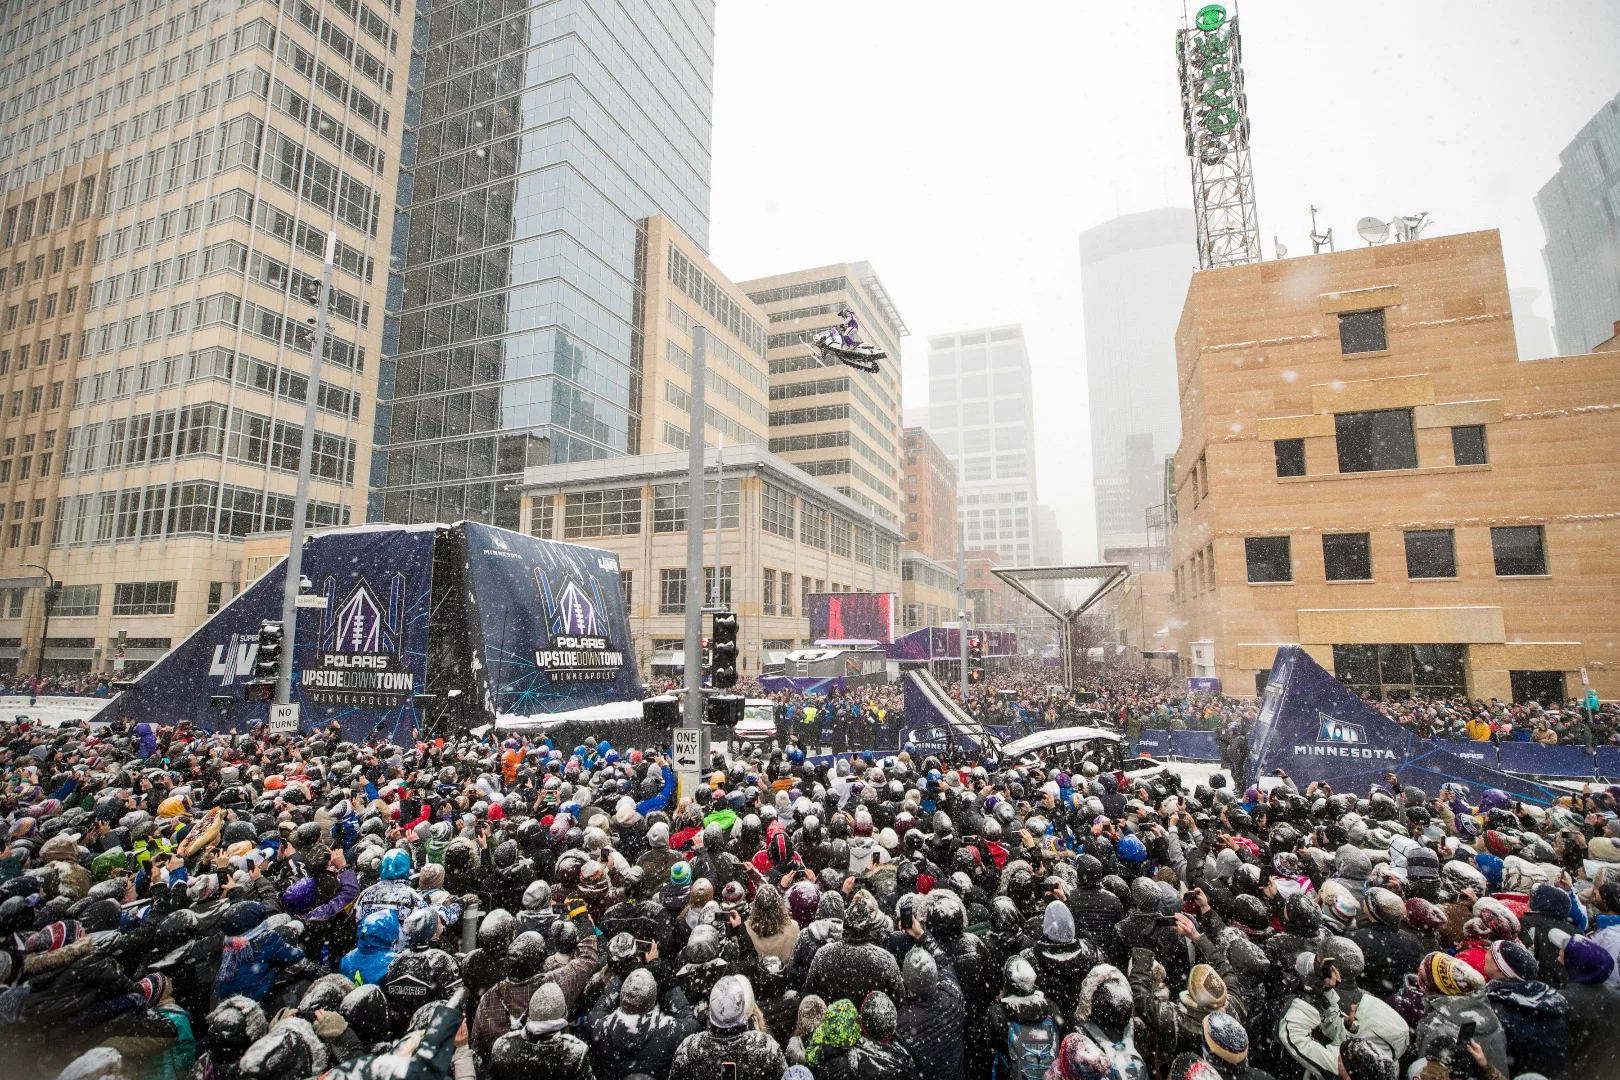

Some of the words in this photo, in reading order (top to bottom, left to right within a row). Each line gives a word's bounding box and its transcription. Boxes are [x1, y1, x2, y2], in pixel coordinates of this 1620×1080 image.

[483, 549, 522, 559] MINNESOTA
[556, 636, 605, 649] POLARIS
[324, 654, 389, 669] POLARIS
[535, 651, 623, 667] UPSIDEDOWNTOWN
[301, 669, 413, 690] UPSIDEDOWNTOWN
[551, 671, 615, 681] MINNEAPOLIS
[313, 693, 398, 706] MINNEAPOLIS
[278, 709, 292, 717] NO
[270, 719, 298, 730] TURNS
[676, 732, 697, 743] ONE
[675, 743, 698, 755] WAY
[1294, 745, 1396, 760] MINNESOTA
[388, 985, 427, 995] POLARIS
